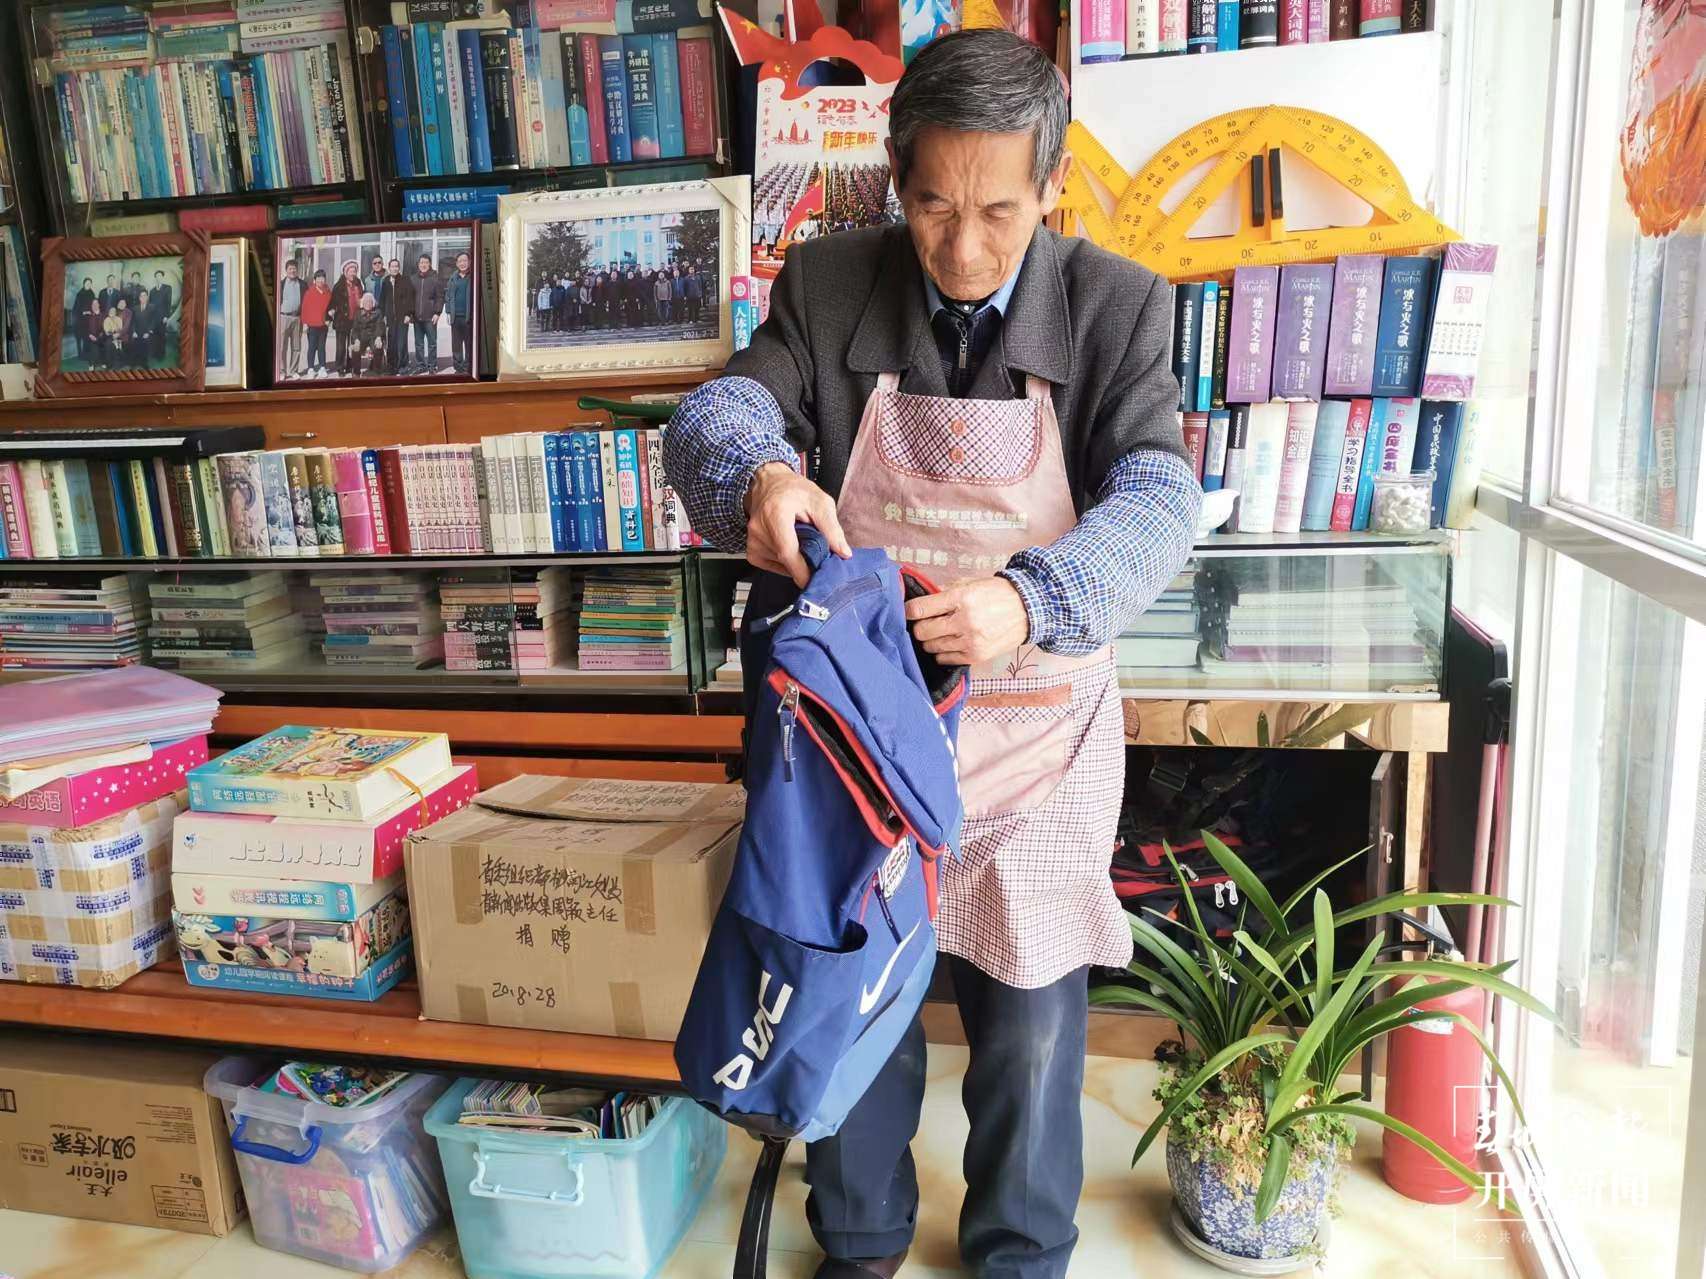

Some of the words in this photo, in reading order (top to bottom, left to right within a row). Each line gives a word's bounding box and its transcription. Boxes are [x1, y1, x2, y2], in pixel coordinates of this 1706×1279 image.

[330, 77, 341, 101] Java
[334, 101, 345, 123] Web
[817, 98, 858, 114] 2023
[1249, 296, 1264, 354] 冰与火之歌
[1298, 294, 1315, 353] 冰与火之歌
[1351, 286, 1368, 345] 冰与火之歌
[1397, 288, 1415, 348] 冰与火之歌
[50, 1131, 137, 1160] 吸水专家
[66, 1164, 129, 1185] elleair
[86, 1183, 114, 1198] 大王
